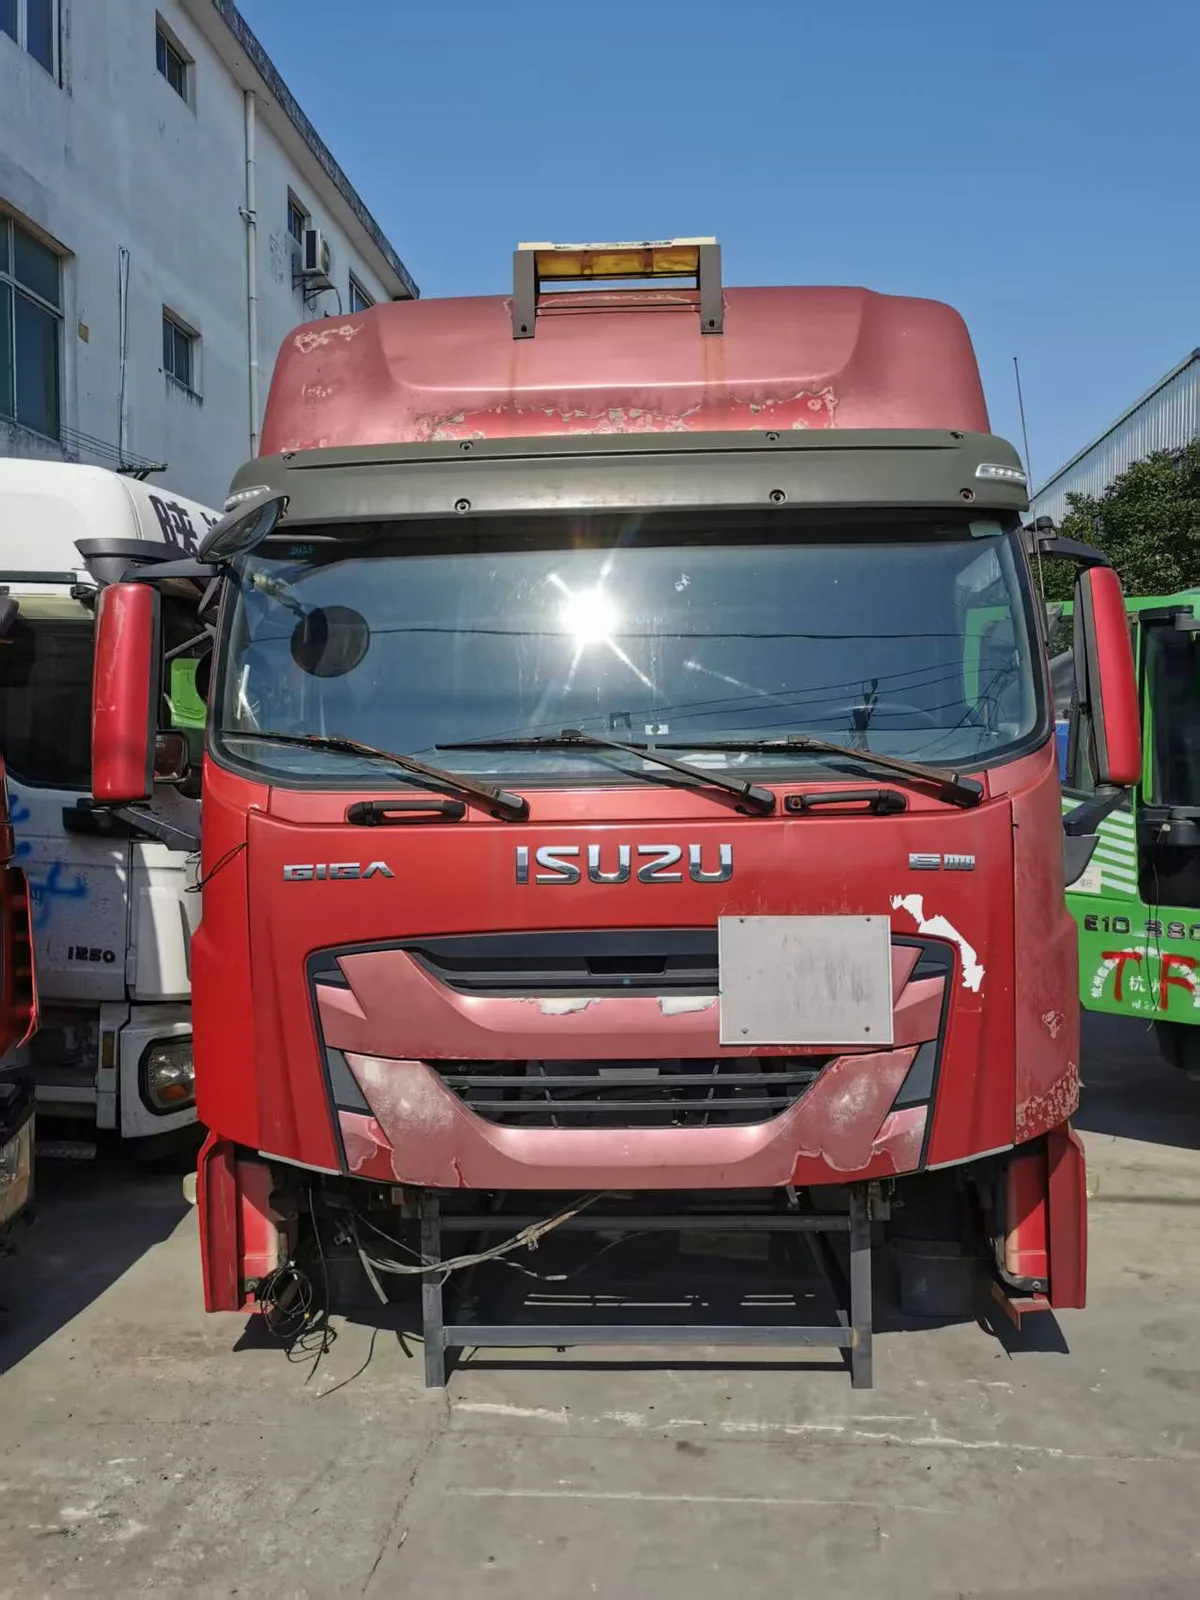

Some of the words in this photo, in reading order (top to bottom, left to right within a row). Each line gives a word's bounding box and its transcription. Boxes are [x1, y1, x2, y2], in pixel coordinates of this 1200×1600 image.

[283, 861, 396, 881] GIGA
[516, 844, 733, 884] ISUZU
[1084, 914, 1130, 934] E10
